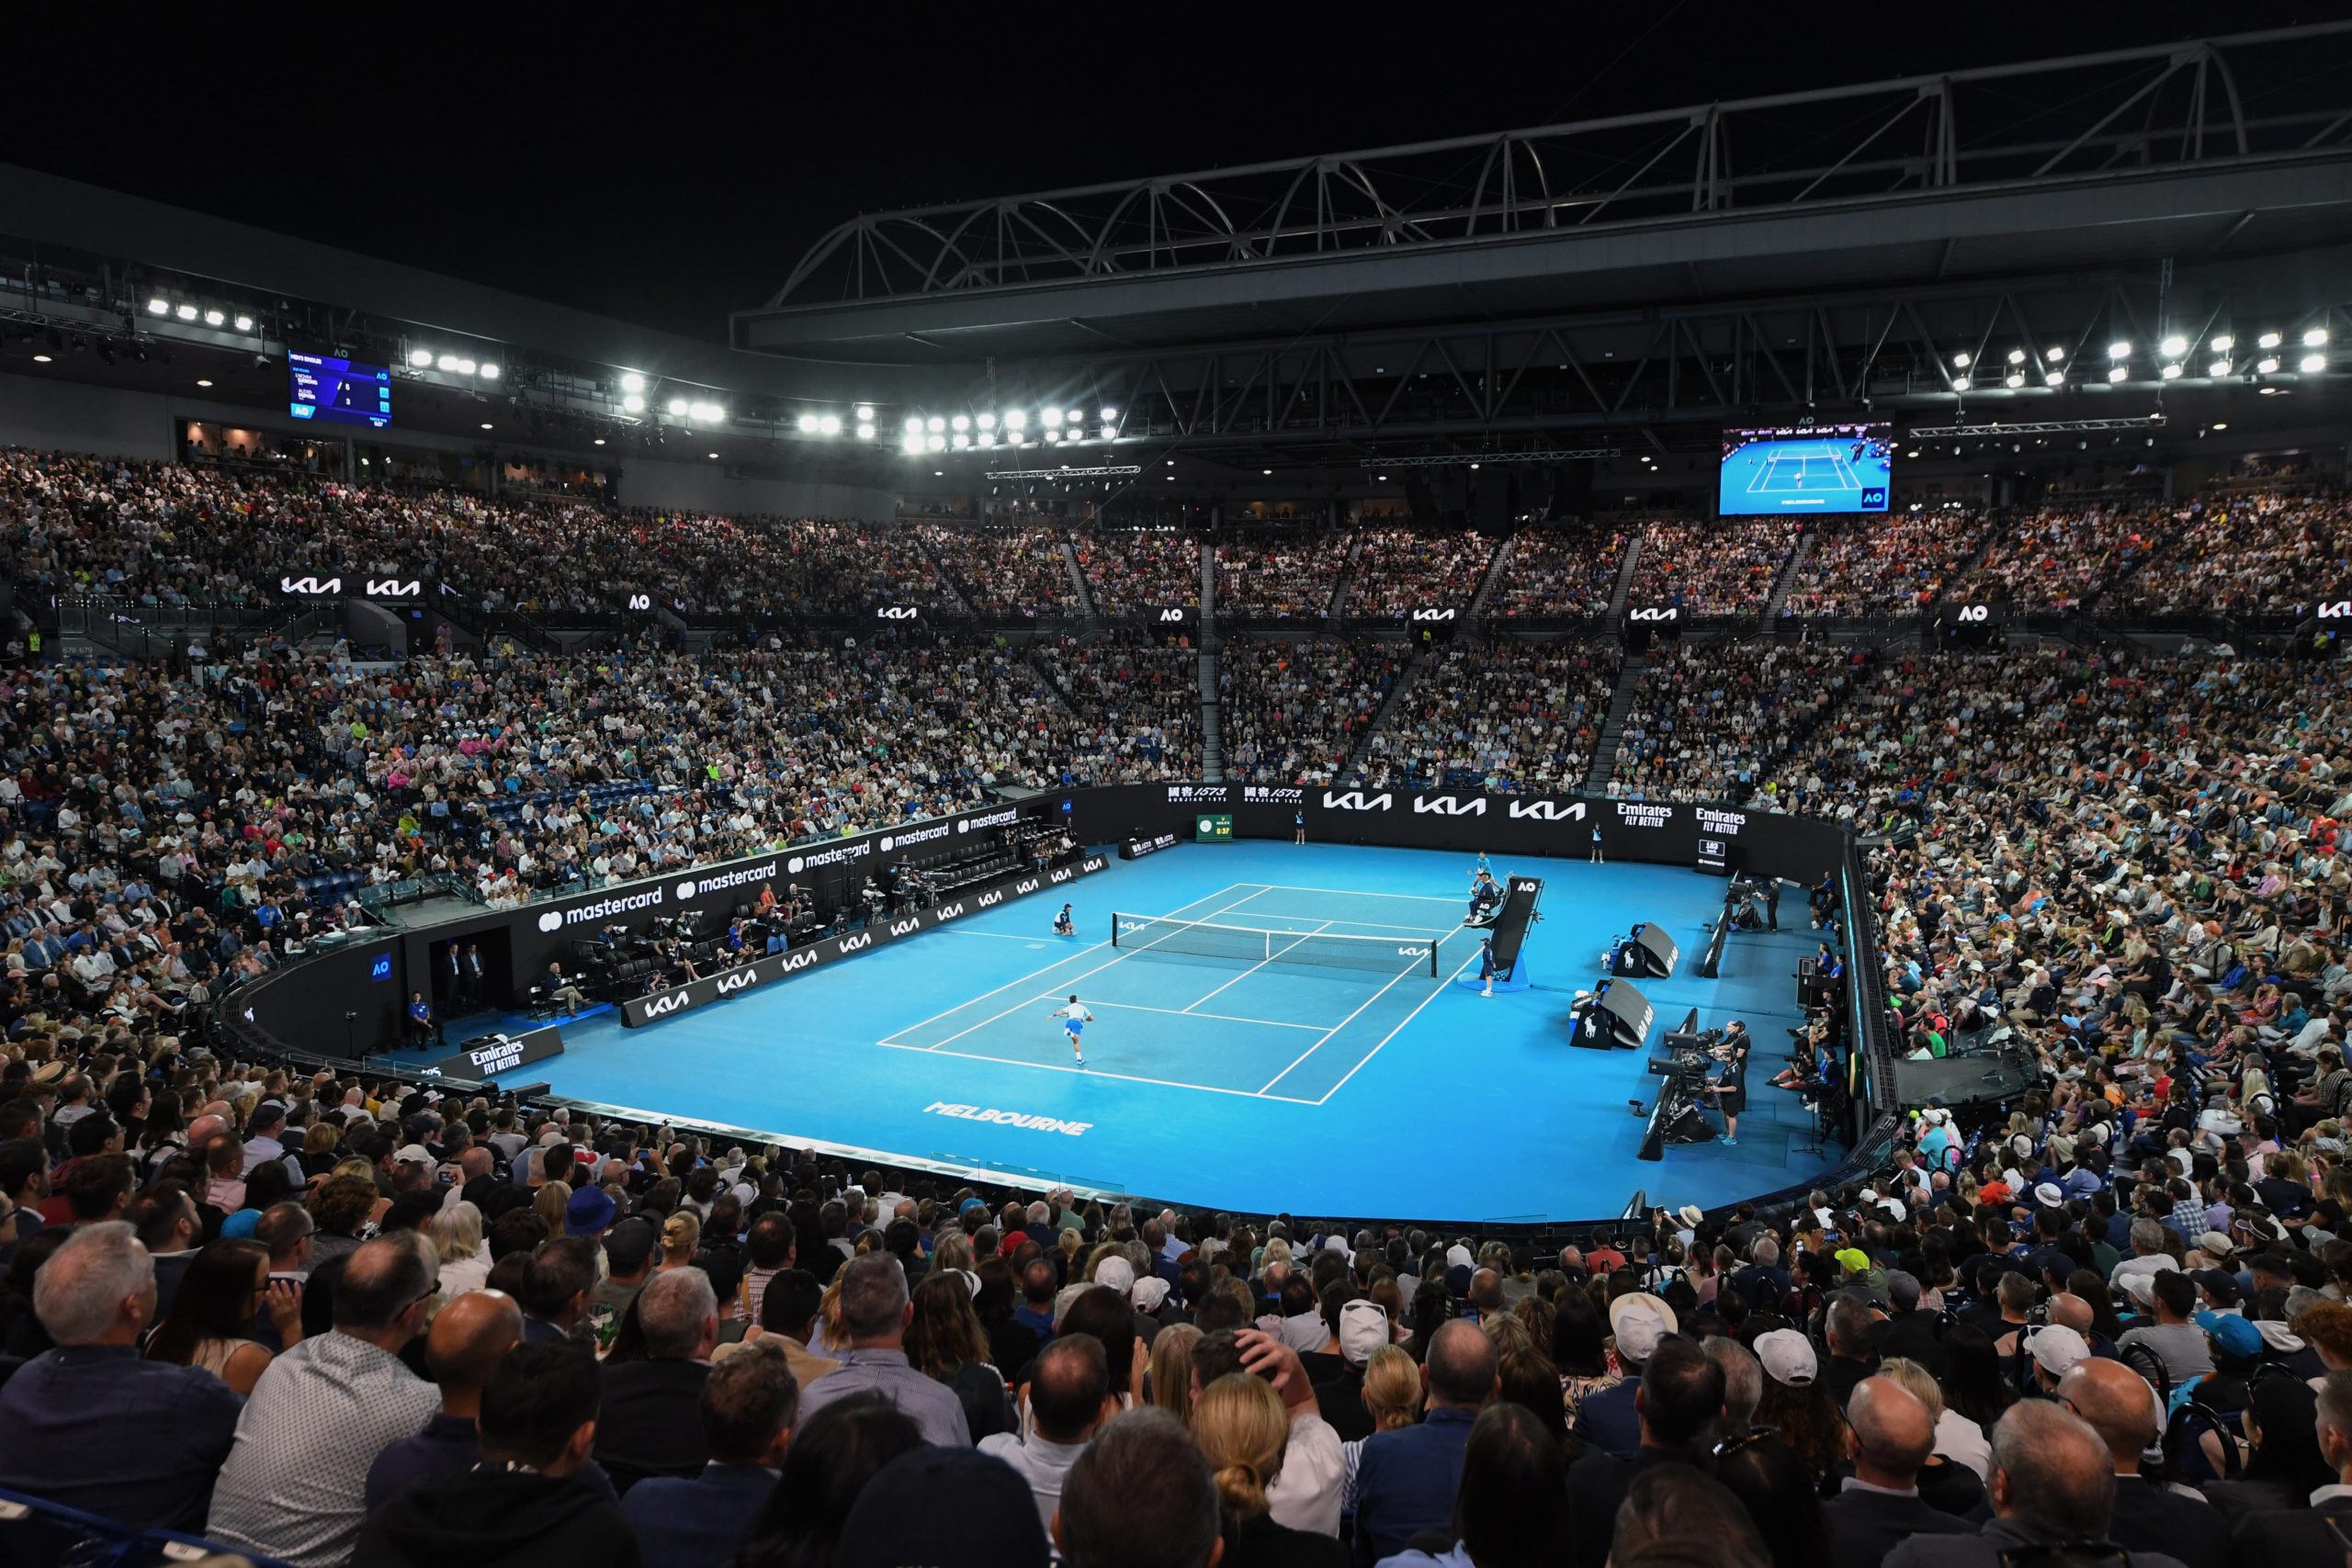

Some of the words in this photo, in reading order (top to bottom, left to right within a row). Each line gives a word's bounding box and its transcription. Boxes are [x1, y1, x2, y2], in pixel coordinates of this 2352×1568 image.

[1863, 492, 1883, 503] AO
[628, 594, 650, 610] AO
[1159, 608, 1182, 622] AO
[1959, 605, 1987, 622] AO
[970, 807, 1017, 829] mastercard
[1617, 802, 1672, 818] Emirates
[1696, 807, 1746, 825] Emirates
[1624, 816, 1636, 826] FLY
[1638, 817, 1664, 828] BETTER
[1702, 821, 1714, 832] FLY
[1714, 822, 1738, 835] BETTER
[895, 822, 949, 848] mastercard
[698, 861, 776, 895] mastercard
[1518, 882, 1536, 892] AO
[567, 886, 662, 924] mastercard
[373, 962, 389, 976] AO
[469, 1041, 525, 1066] Emirates
[483, 1061, 496, 1075] FLY
[496, 1054, 521, 1071] BETTER
[922, 1101, 1094, 1136] MELBOURNE
